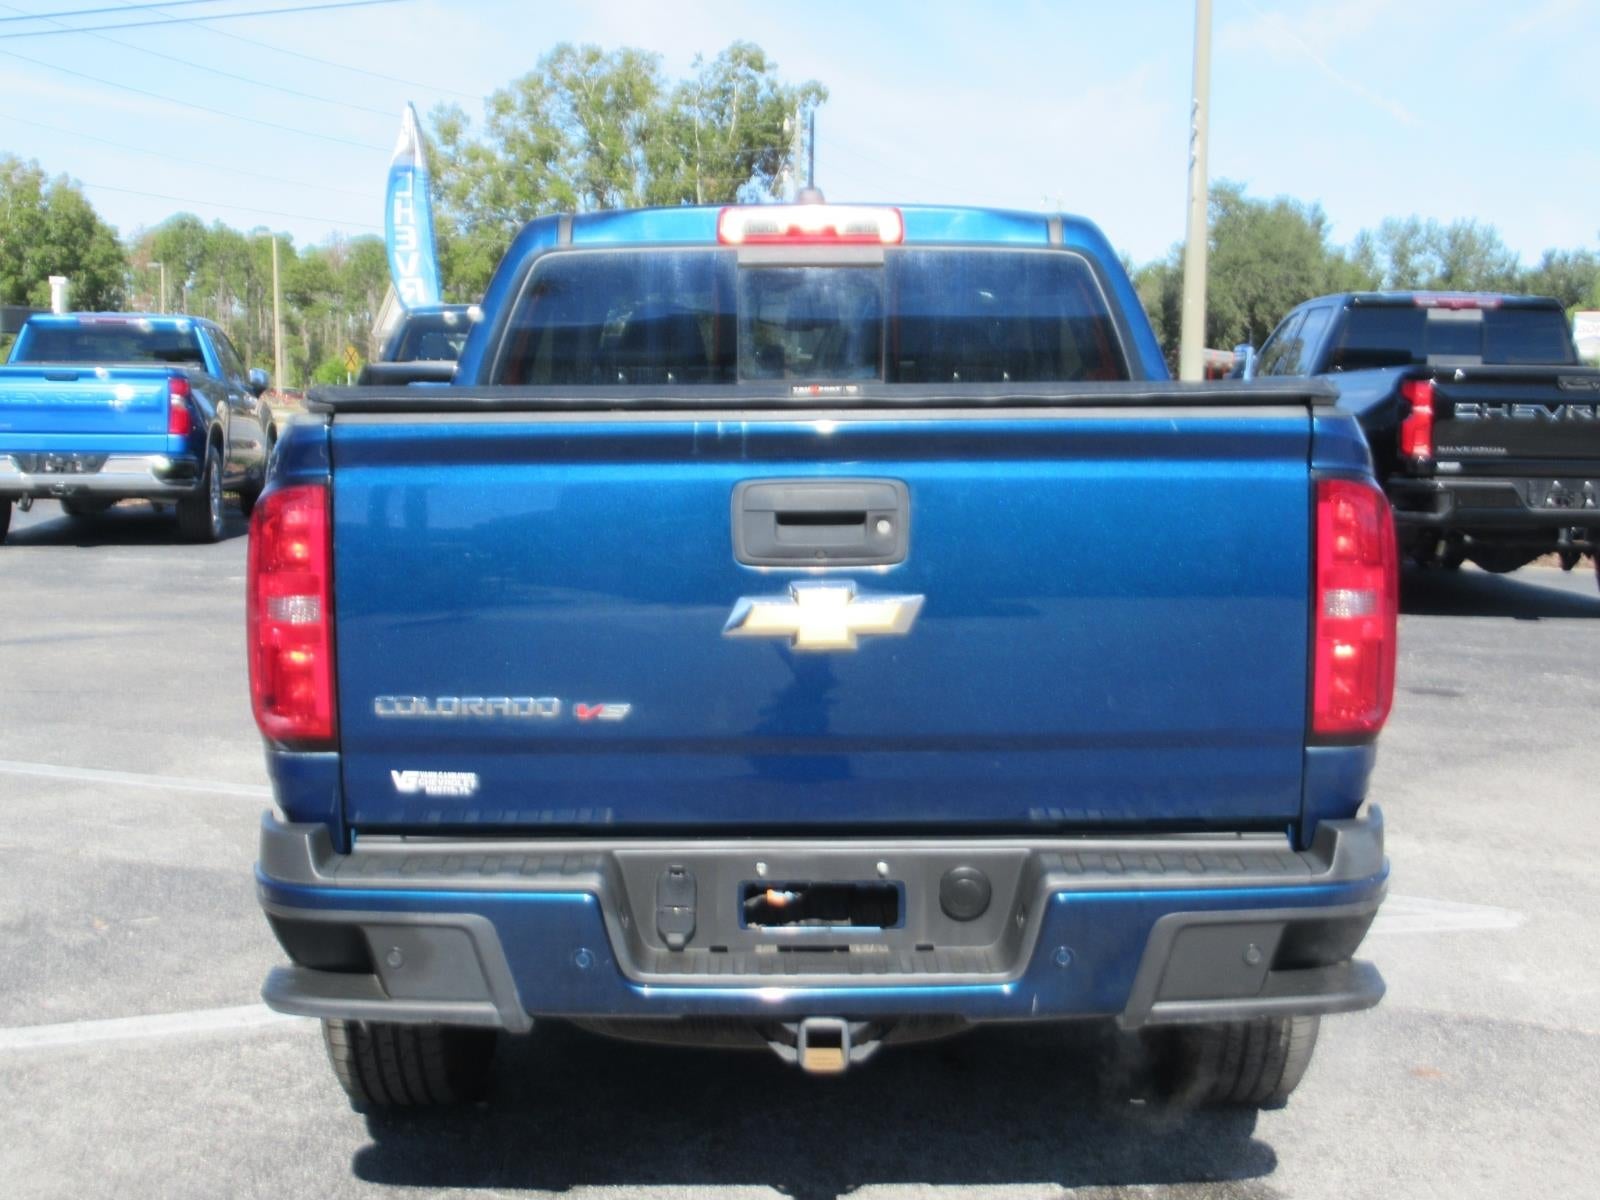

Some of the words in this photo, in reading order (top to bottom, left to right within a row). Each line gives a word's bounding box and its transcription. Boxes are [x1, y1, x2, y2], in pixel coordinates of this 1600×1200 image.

[1454, 402, 1600, 420] CHEVR
[375, 696, 562, 717] COLORADO
[573, 703, 632, 721] V6
